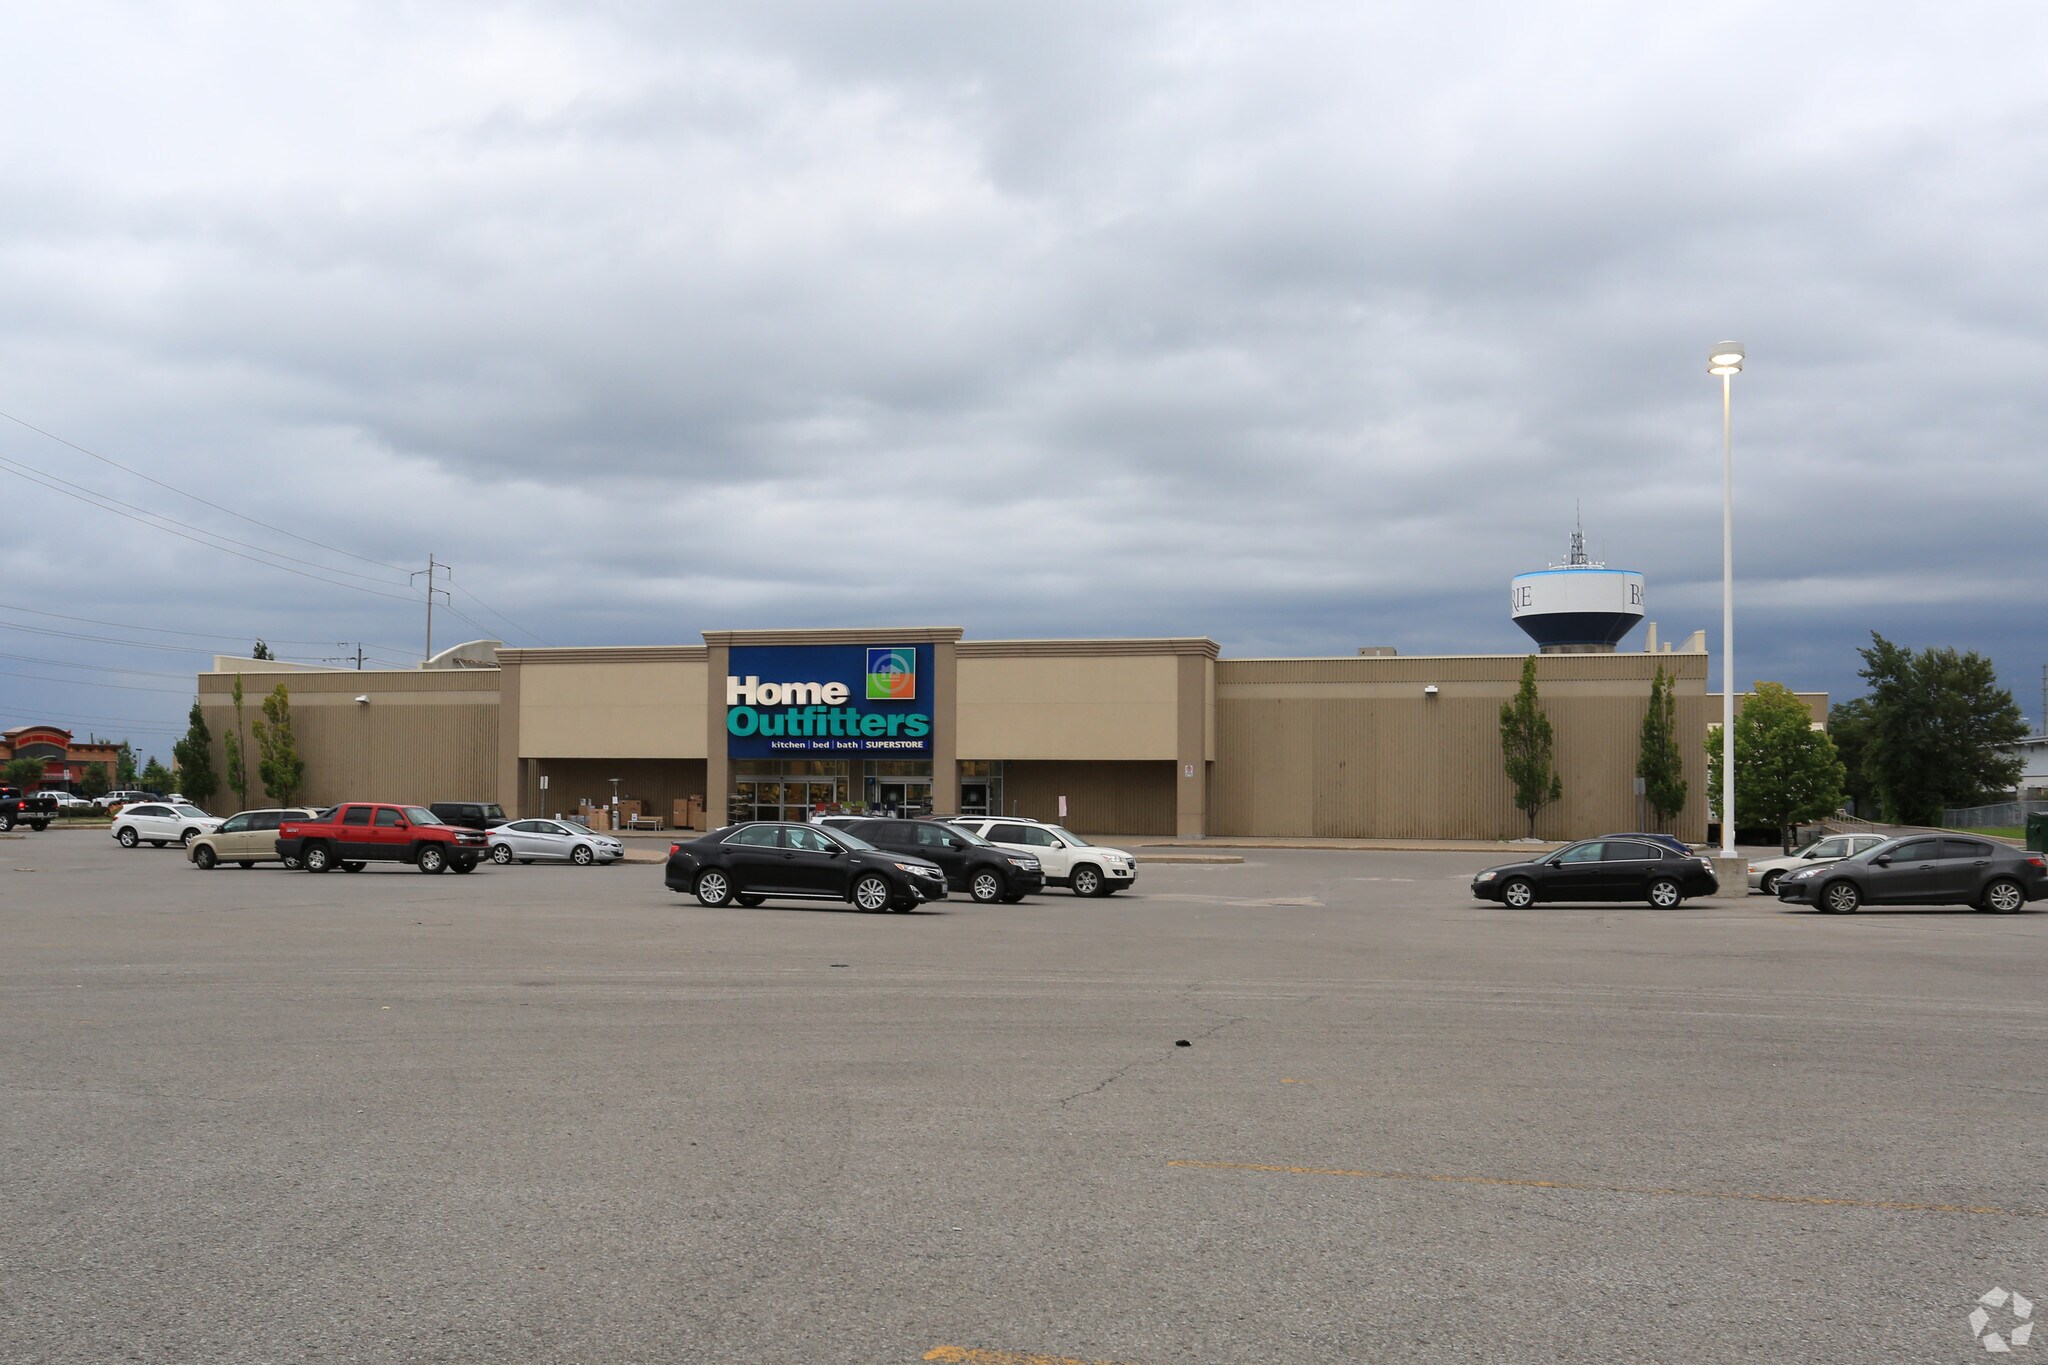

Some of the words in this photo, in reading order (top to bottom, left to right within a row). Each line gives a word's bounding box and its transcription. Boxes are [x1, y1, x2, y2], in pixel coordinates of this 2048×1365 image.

[726, 675, 850, 706] Home
[726, 705, 930, 737] Outfitters
[771, 740, 806, 749] kitchen
[812, 740, 830, 749] bed
[836, 740, 858, 749] bath
[865, 740, 924, 749] SUPERSTORE
